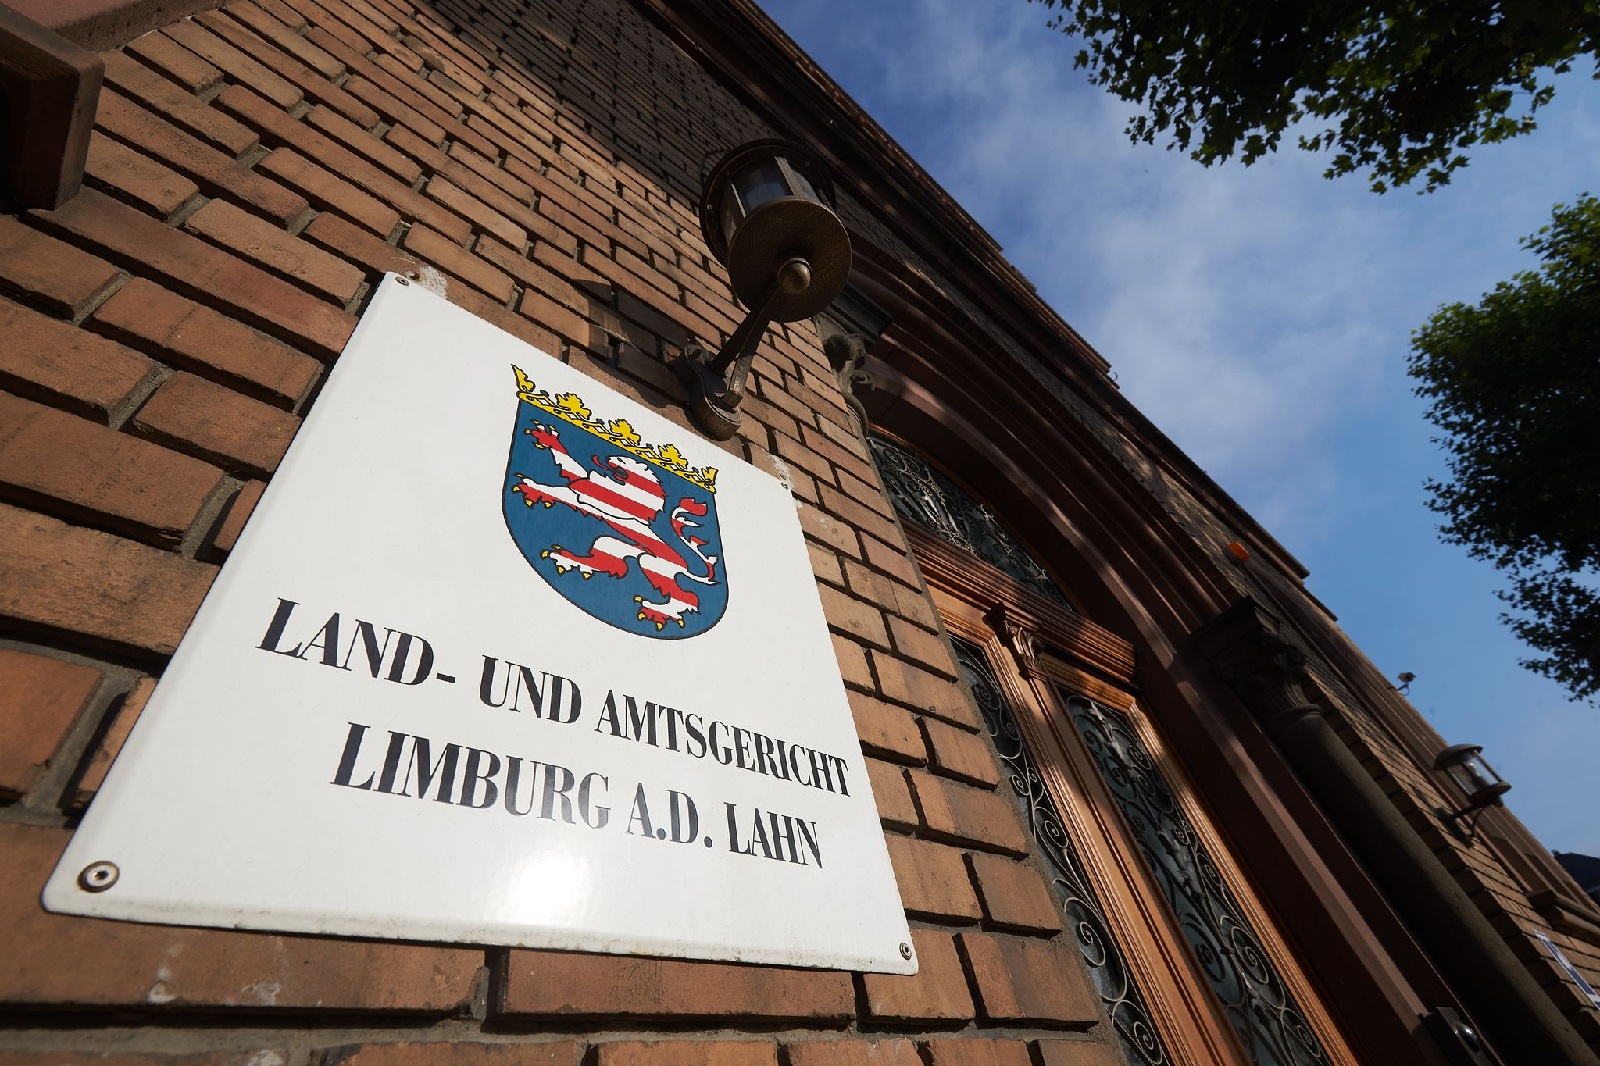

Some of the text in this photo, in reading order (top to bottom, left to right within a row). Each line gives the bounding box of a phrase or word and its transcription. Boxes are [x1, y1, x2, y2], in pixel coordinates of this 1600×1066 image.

[255, 597, 851, 797] LAND- UND AMTSGERICHT
[330, 722, 824, 869] LIMBURG A.D. LAHN
